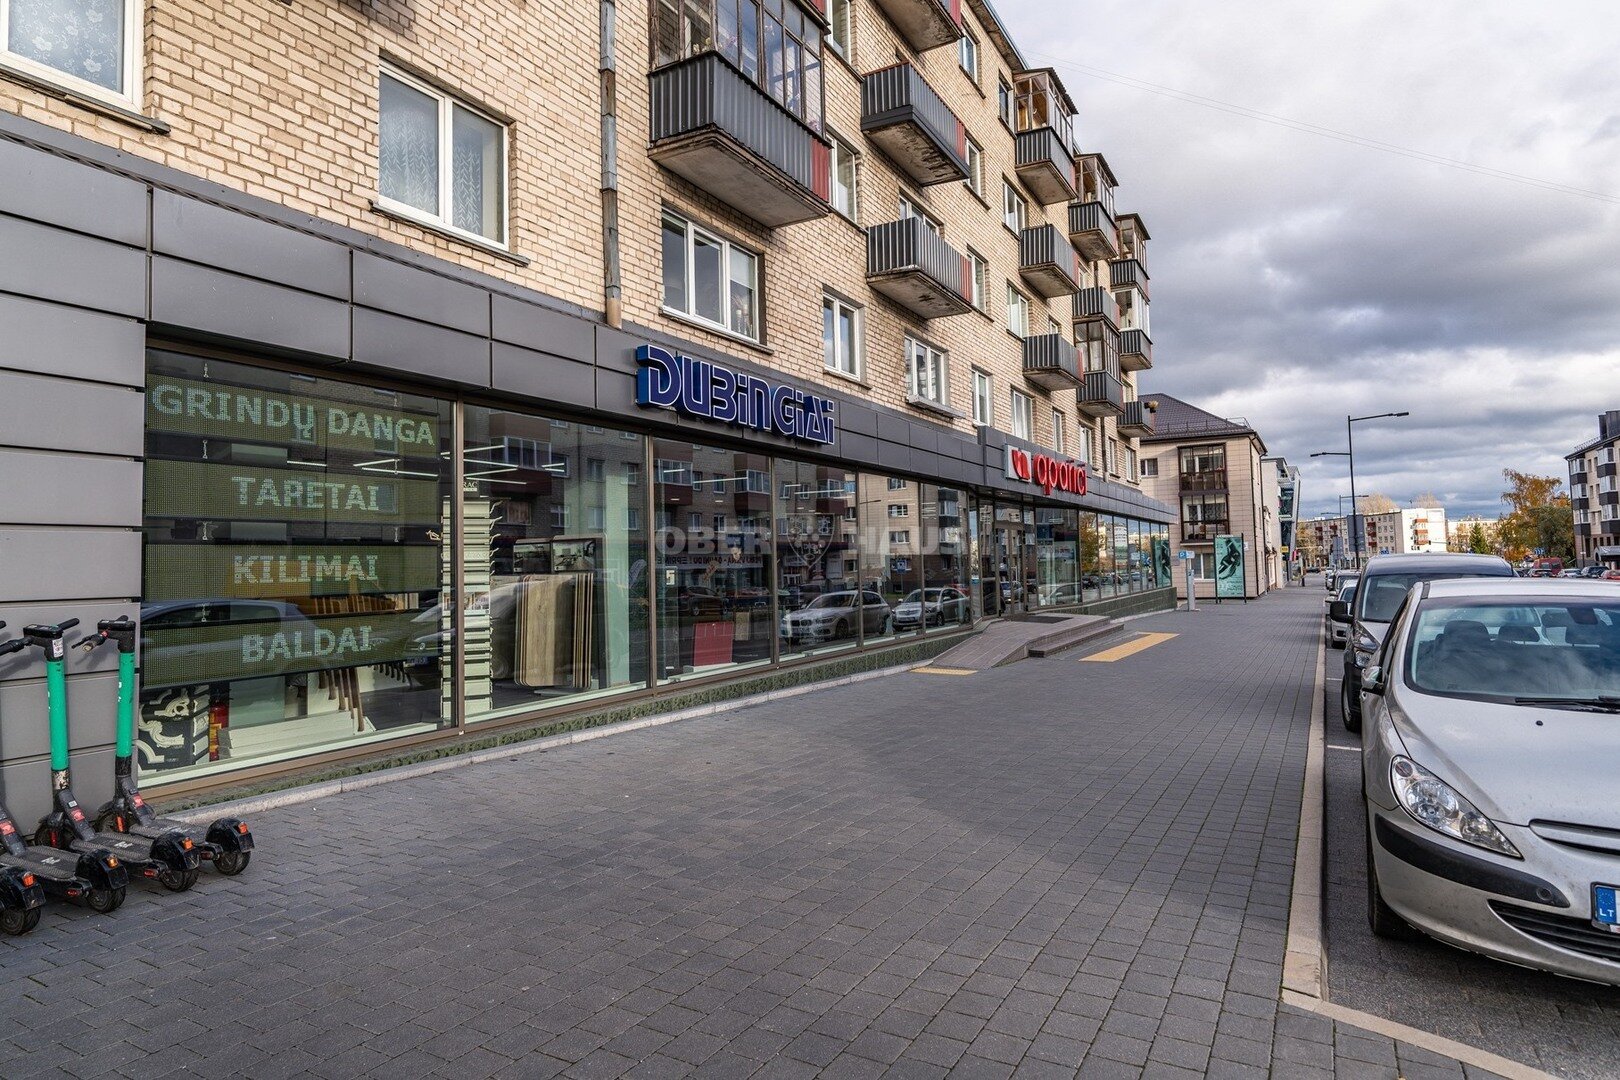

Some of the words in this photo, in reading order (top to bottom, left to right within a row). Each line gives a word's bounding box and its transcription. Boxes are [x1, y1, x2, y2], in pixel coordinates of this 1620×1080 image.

[152, 383, 316, 438] GRINDŲ
[327, 407, 436, 446] DANGA
[231, 476, 380, 512] TAPETAI
[233, 554, 380, 585] KILIMAI
[242, 625, 373, 664] BALDAI
[1599, 908, 1615, 917] LT
